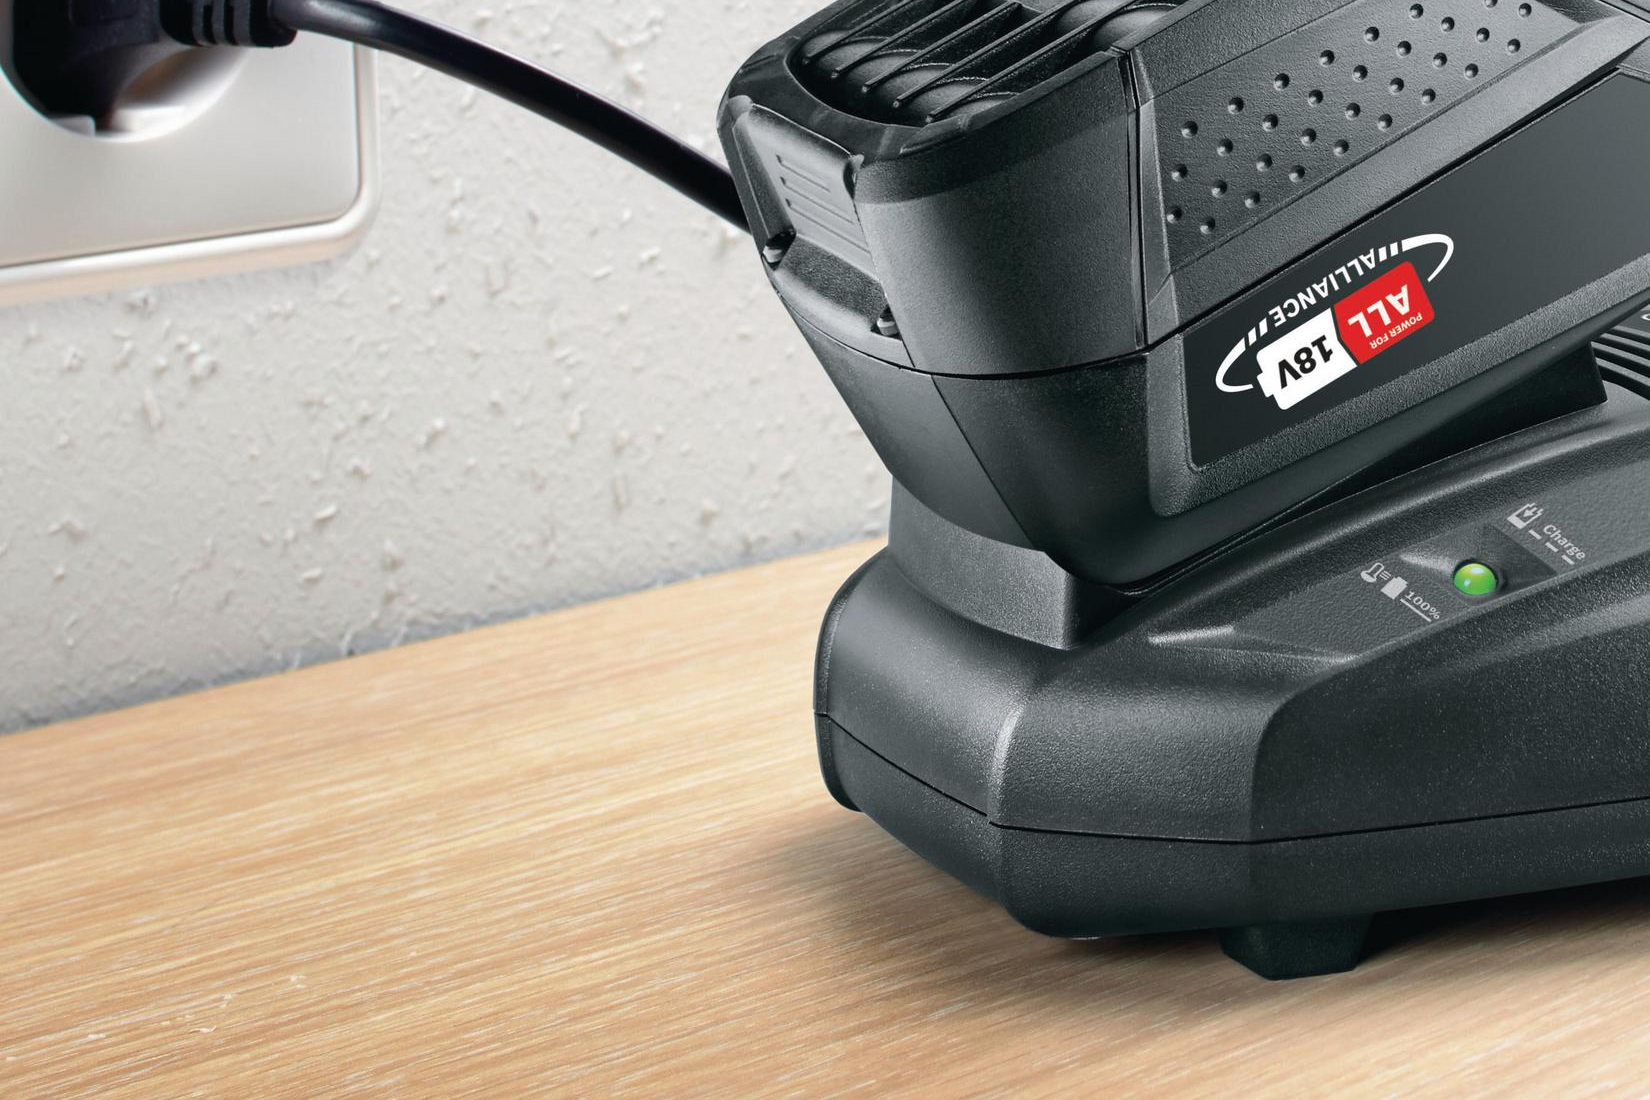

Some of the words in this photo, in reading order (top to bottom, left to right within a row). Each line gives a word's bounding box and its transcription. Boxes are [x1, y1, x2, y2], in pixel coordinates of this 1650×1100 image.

[1269, 248, 1375, 327] ALLIANCE
[1348, 284, 1410, 338] ALL
[1388, 312, 1423, 337] POWER
[1370, 333, 1389, 349] FOR
[1277, 335, 1333, 389] 18V
[1542, 524, 1586, 560] Charge
[1404, 590, 1440, 620] 100%
